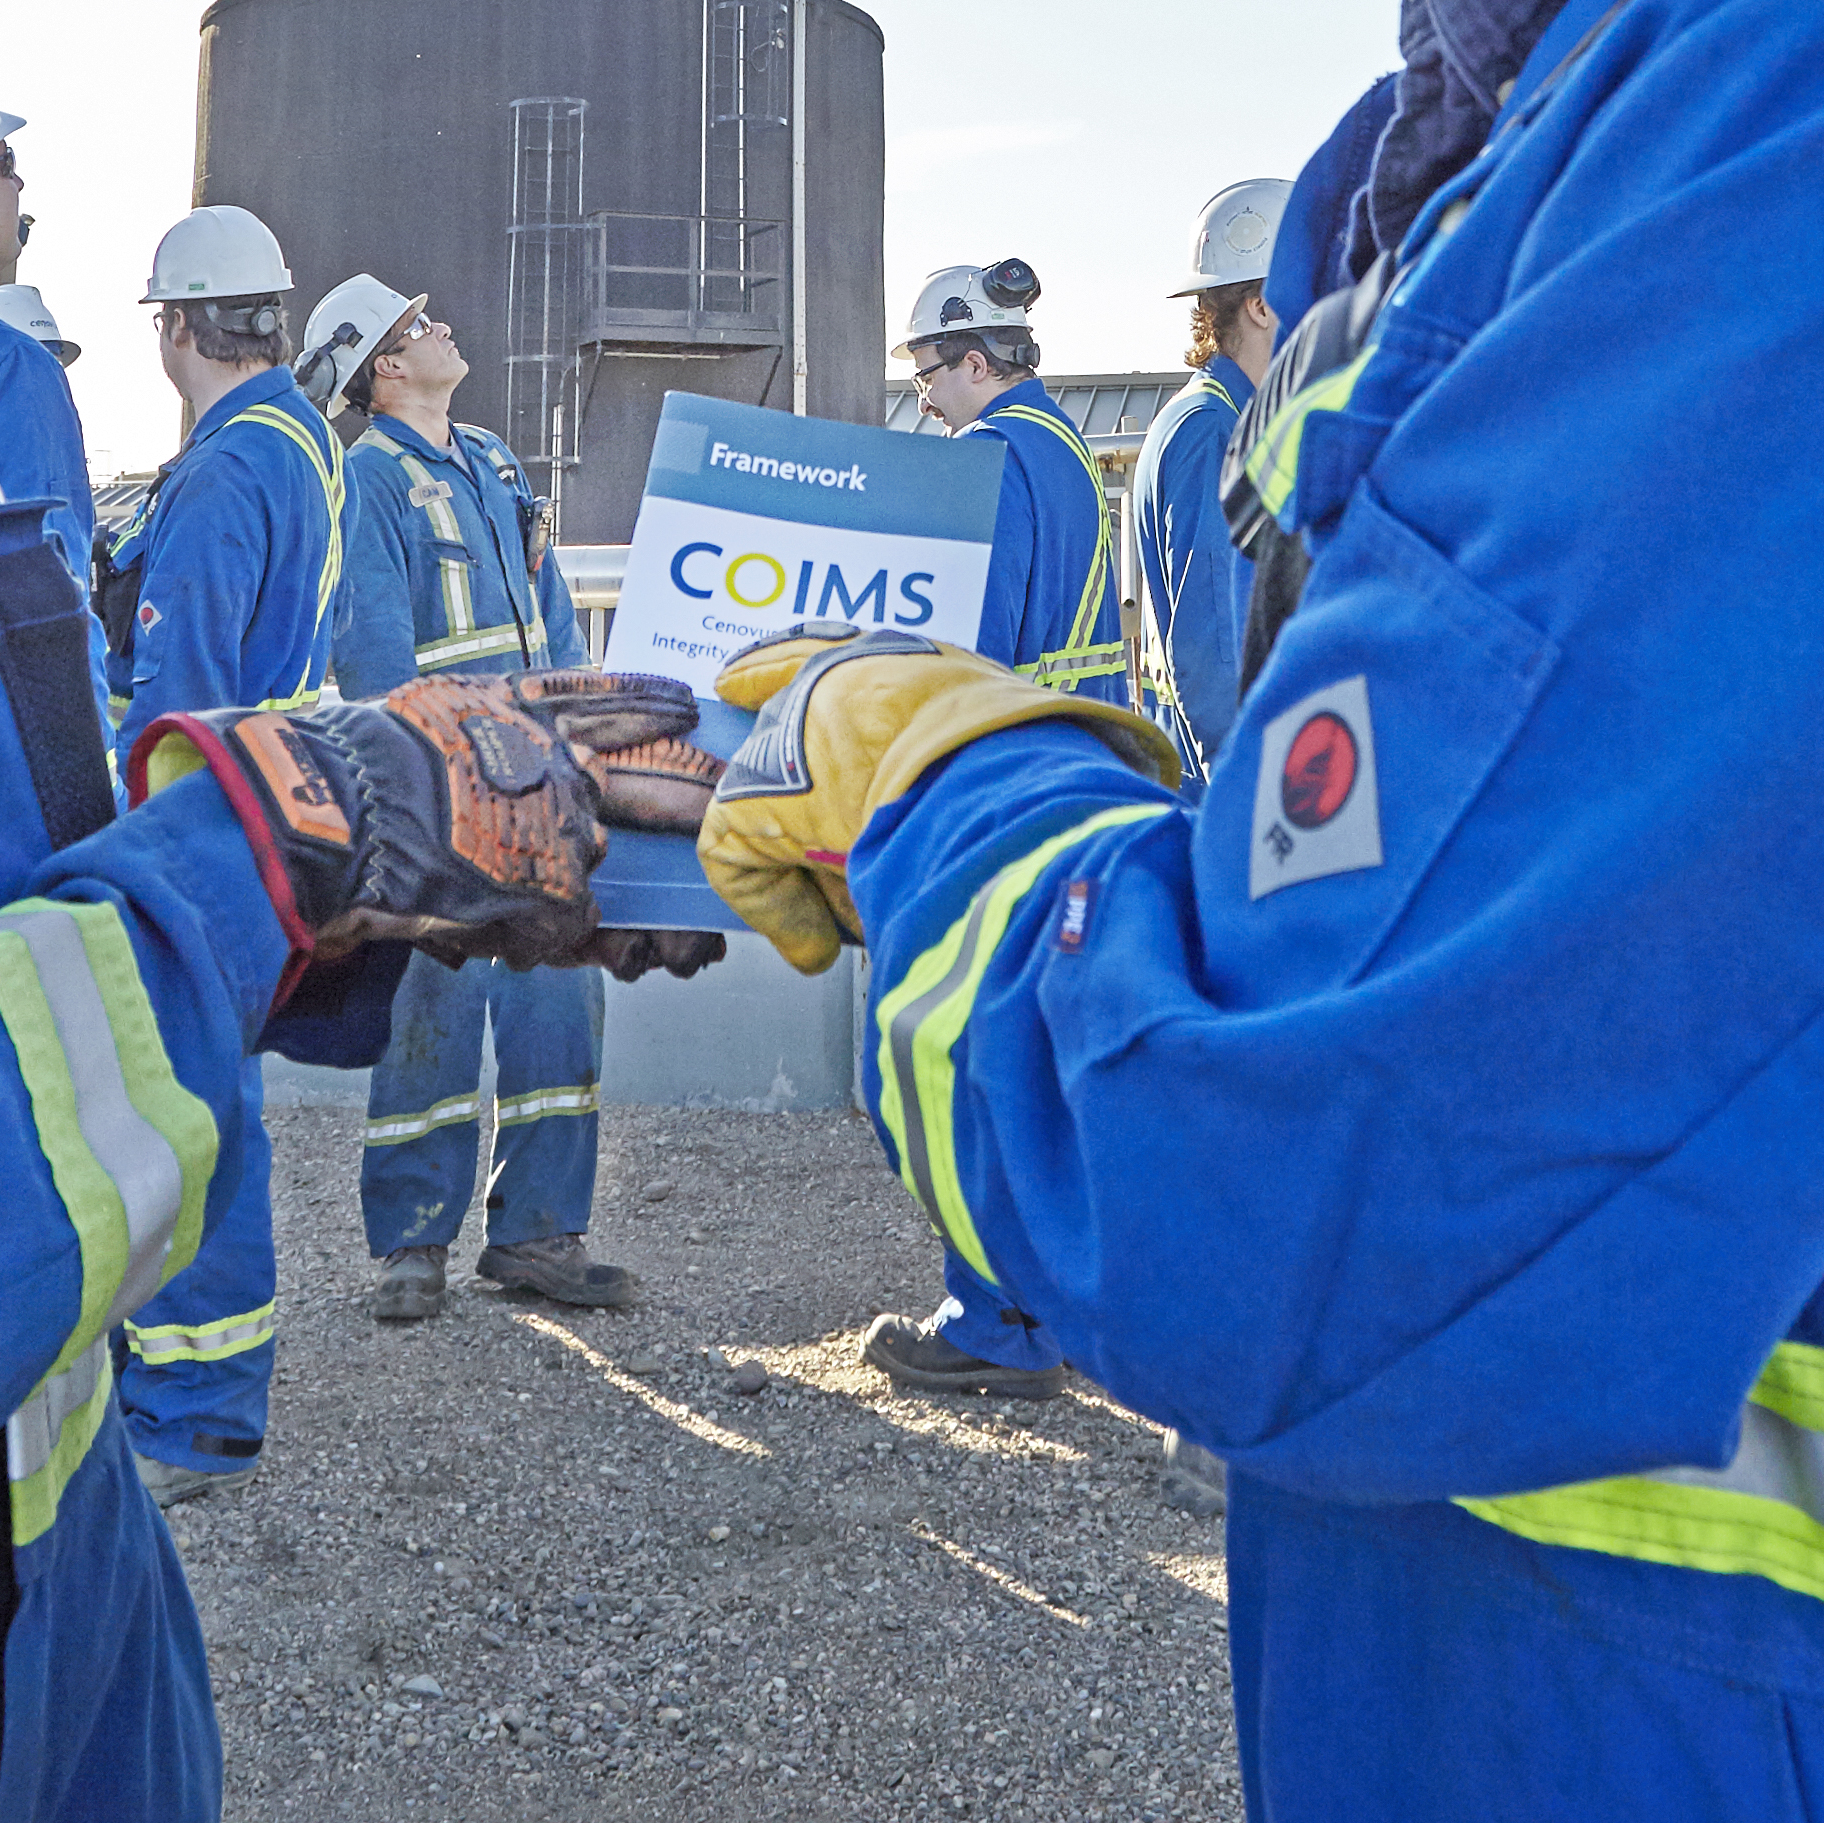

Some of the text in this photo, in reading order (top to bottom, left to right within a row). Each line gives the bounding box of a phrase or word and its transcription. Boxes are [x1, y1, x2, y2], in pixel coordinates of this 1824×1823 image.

[708, 442, 868, 493] Framework
[670, 541, 935, 627] COIMS
[652, 631, 730, 664] Integrity
